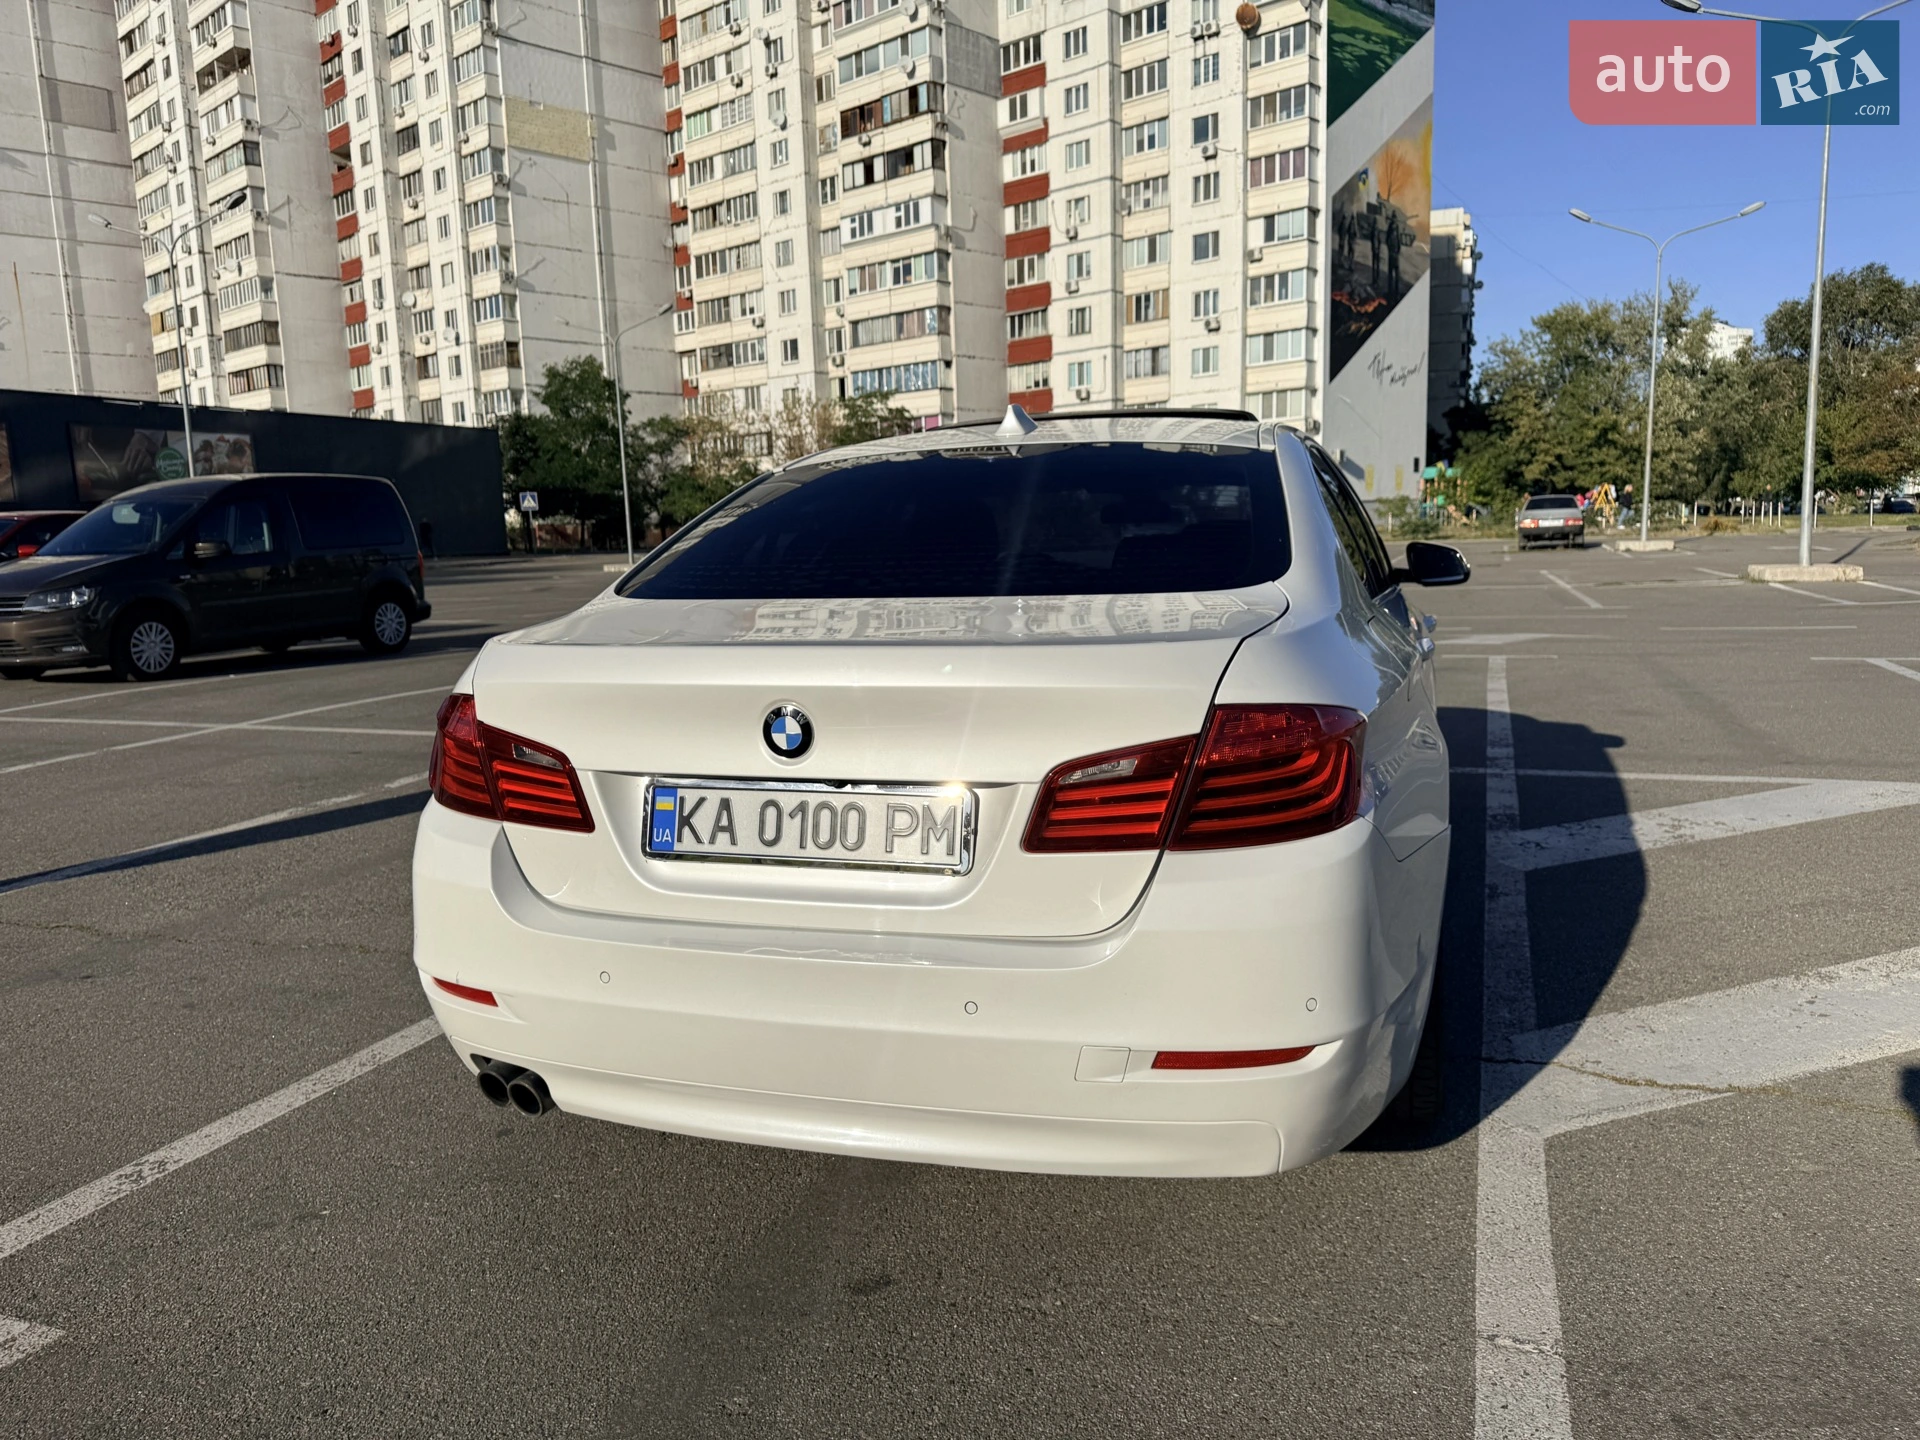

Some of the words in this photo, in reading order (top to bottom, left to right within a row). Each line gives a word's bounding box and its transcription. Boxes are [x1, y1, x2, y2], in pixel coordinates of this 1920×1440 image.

[766, 706, 810, 725] BMW
[653, 827, 672, 843] UA
[676, 795, 738, 846] KA
[758, 798, 867, 851] 0100
[885, 802, 956, 856] PM
